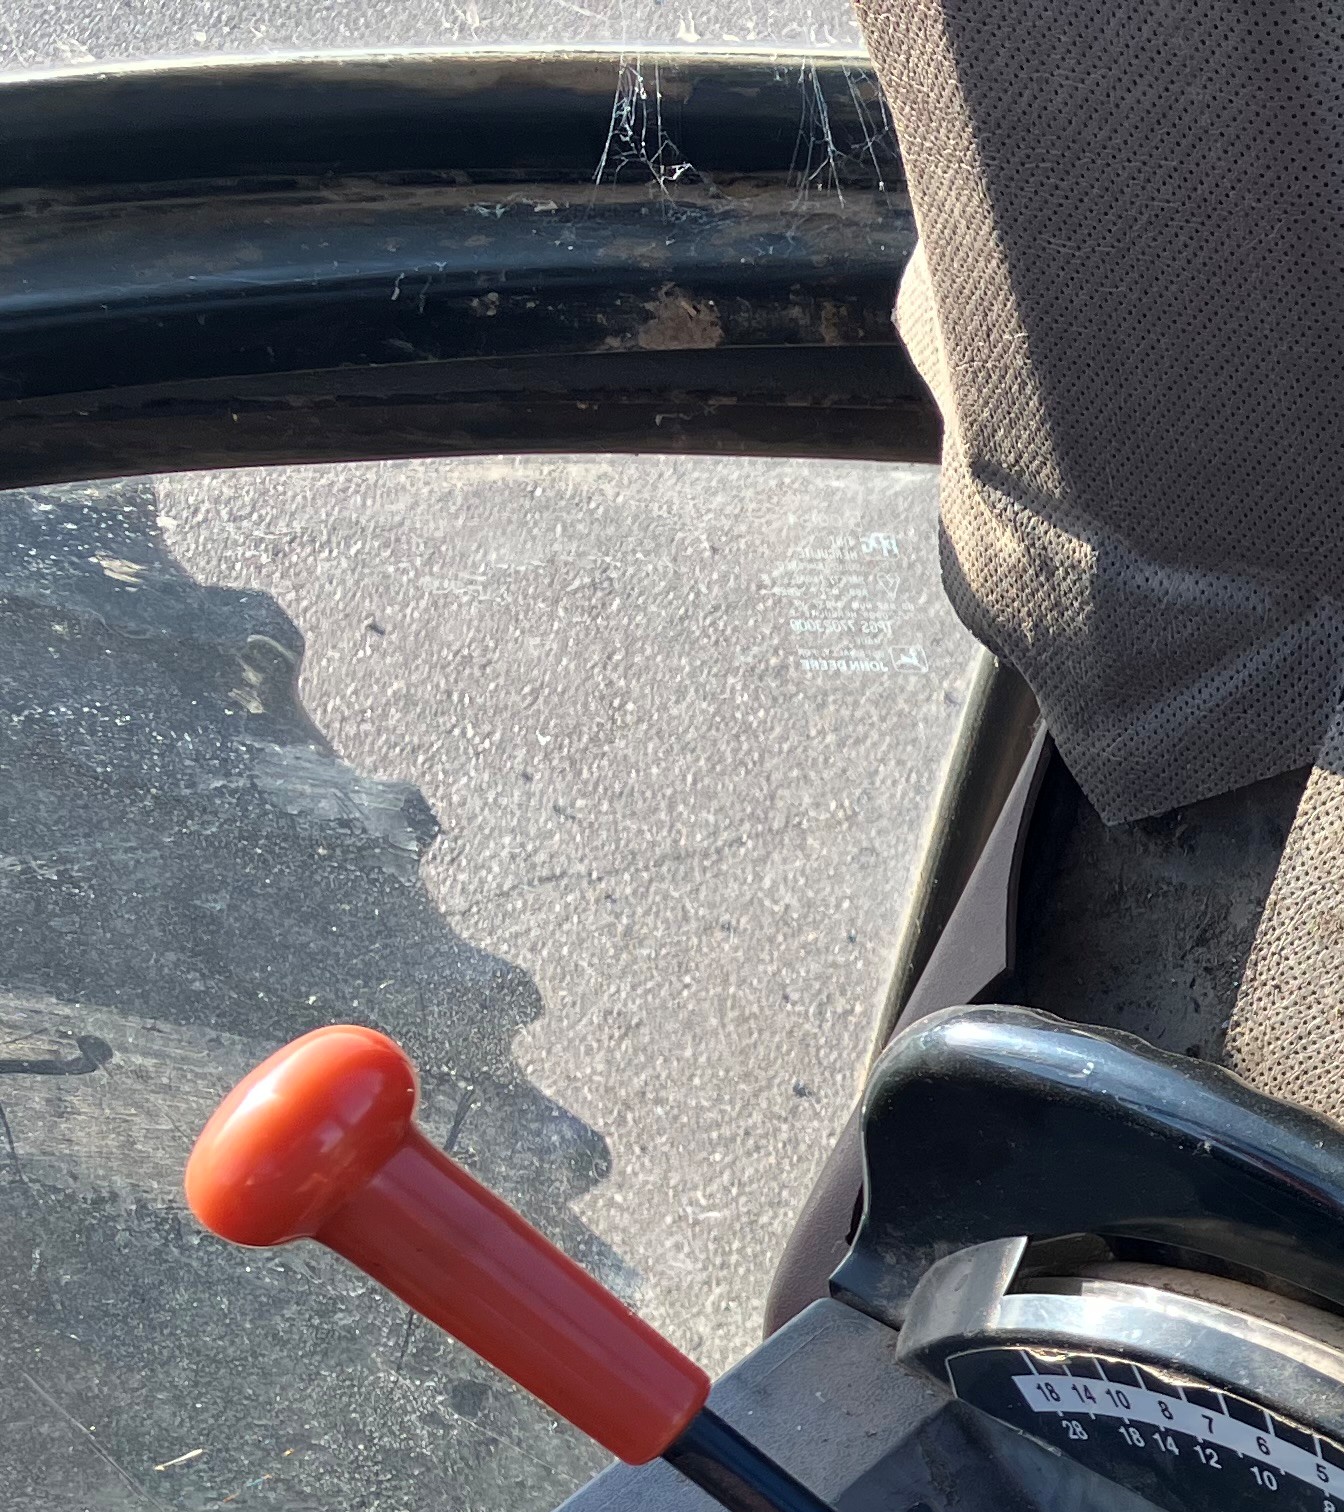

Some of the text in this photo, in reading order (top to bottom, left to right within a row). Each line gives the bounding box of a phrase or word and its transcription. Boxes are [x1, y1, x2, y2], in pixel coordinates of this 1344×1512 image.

[1036, 1382, 1061, 1402] 18
[1071, 1383, 1097, 1404] 14
[1105, 1388, 1131, 1410] 10
[1157, 1400, 1173, 1420] 8
[1201, 1414, 1214, 1434] 7
[1256, 1436, 1271, 1456] 6
[1315, 1463, 1329, 1483] 5
[1062, 1420, 1088, 1440] 28
[1119, 1425, 1146, 1448] 18
[1152, 1432, 1180, 1456] 14
[1194, 1444, 1222, 1469] 12
[1250, 1465, 1278, 1491] 10
